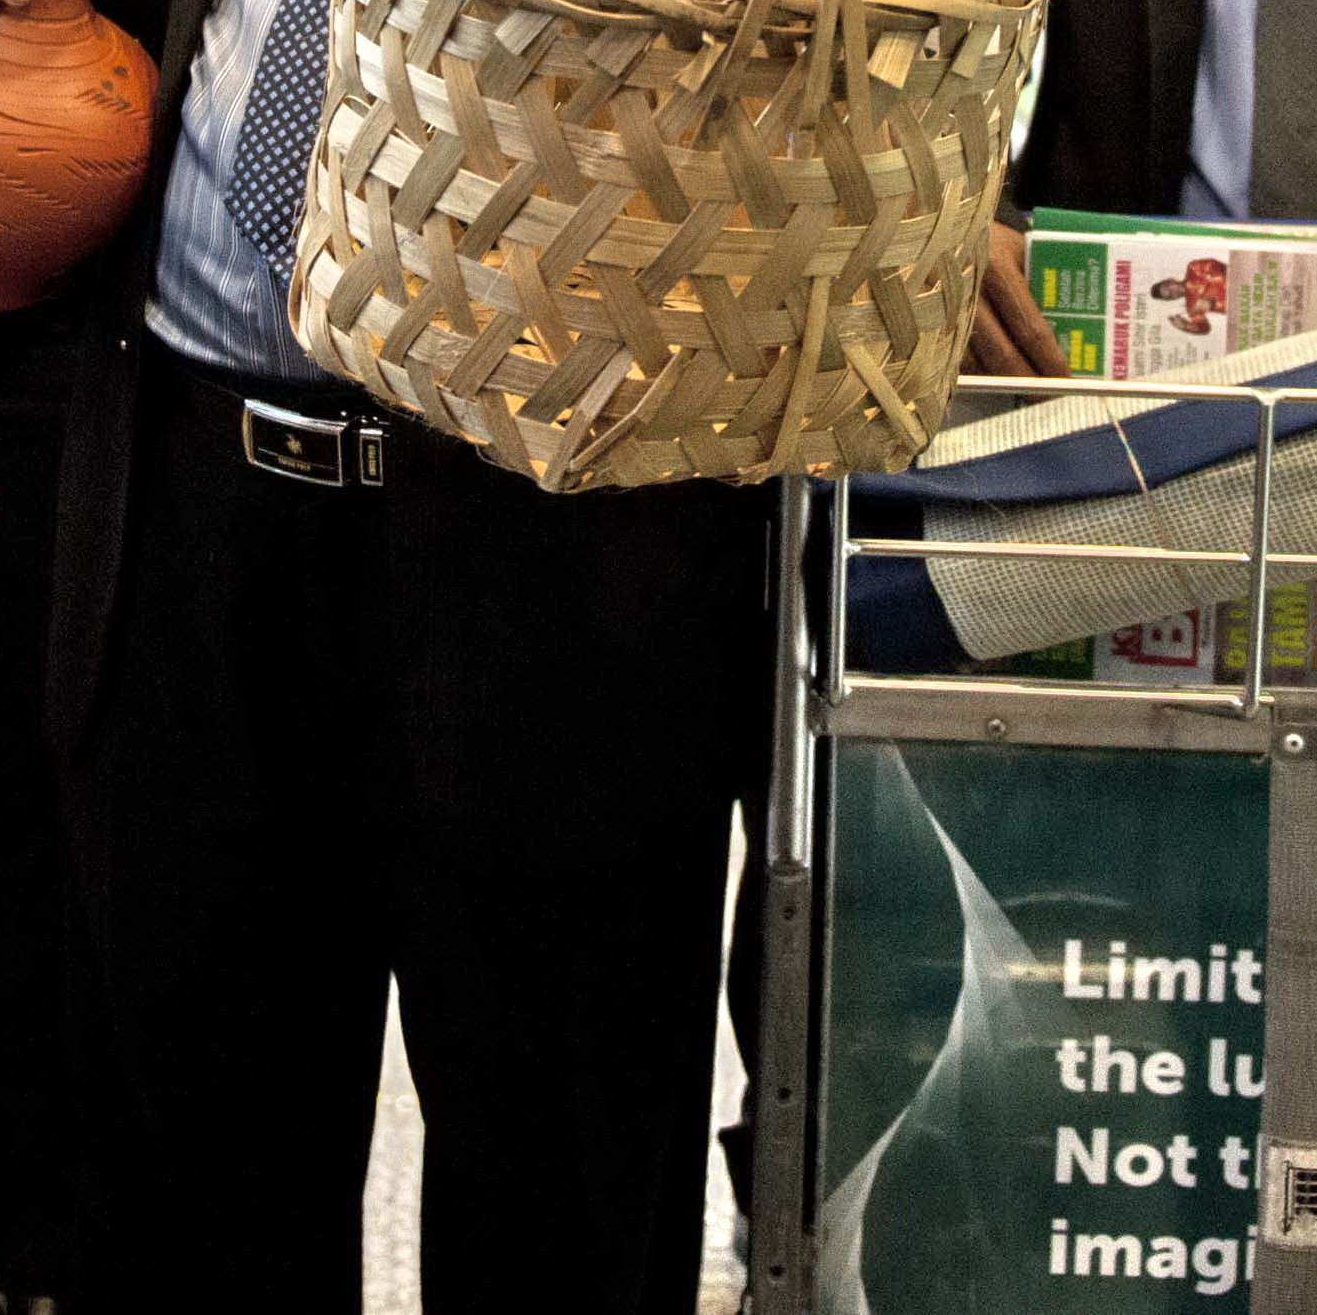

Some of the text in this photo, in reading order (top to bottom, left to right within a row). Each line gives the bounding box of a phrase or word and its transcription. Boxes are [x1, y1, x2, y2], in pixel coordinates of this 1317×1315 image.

[1115, 260, 1131, 319] POLIGAMI
[1063, 939, 1263, 1004] Limit
[1055, 1034, 1186, 1096] the
[1054, 1126, 1198, 1189] Not
